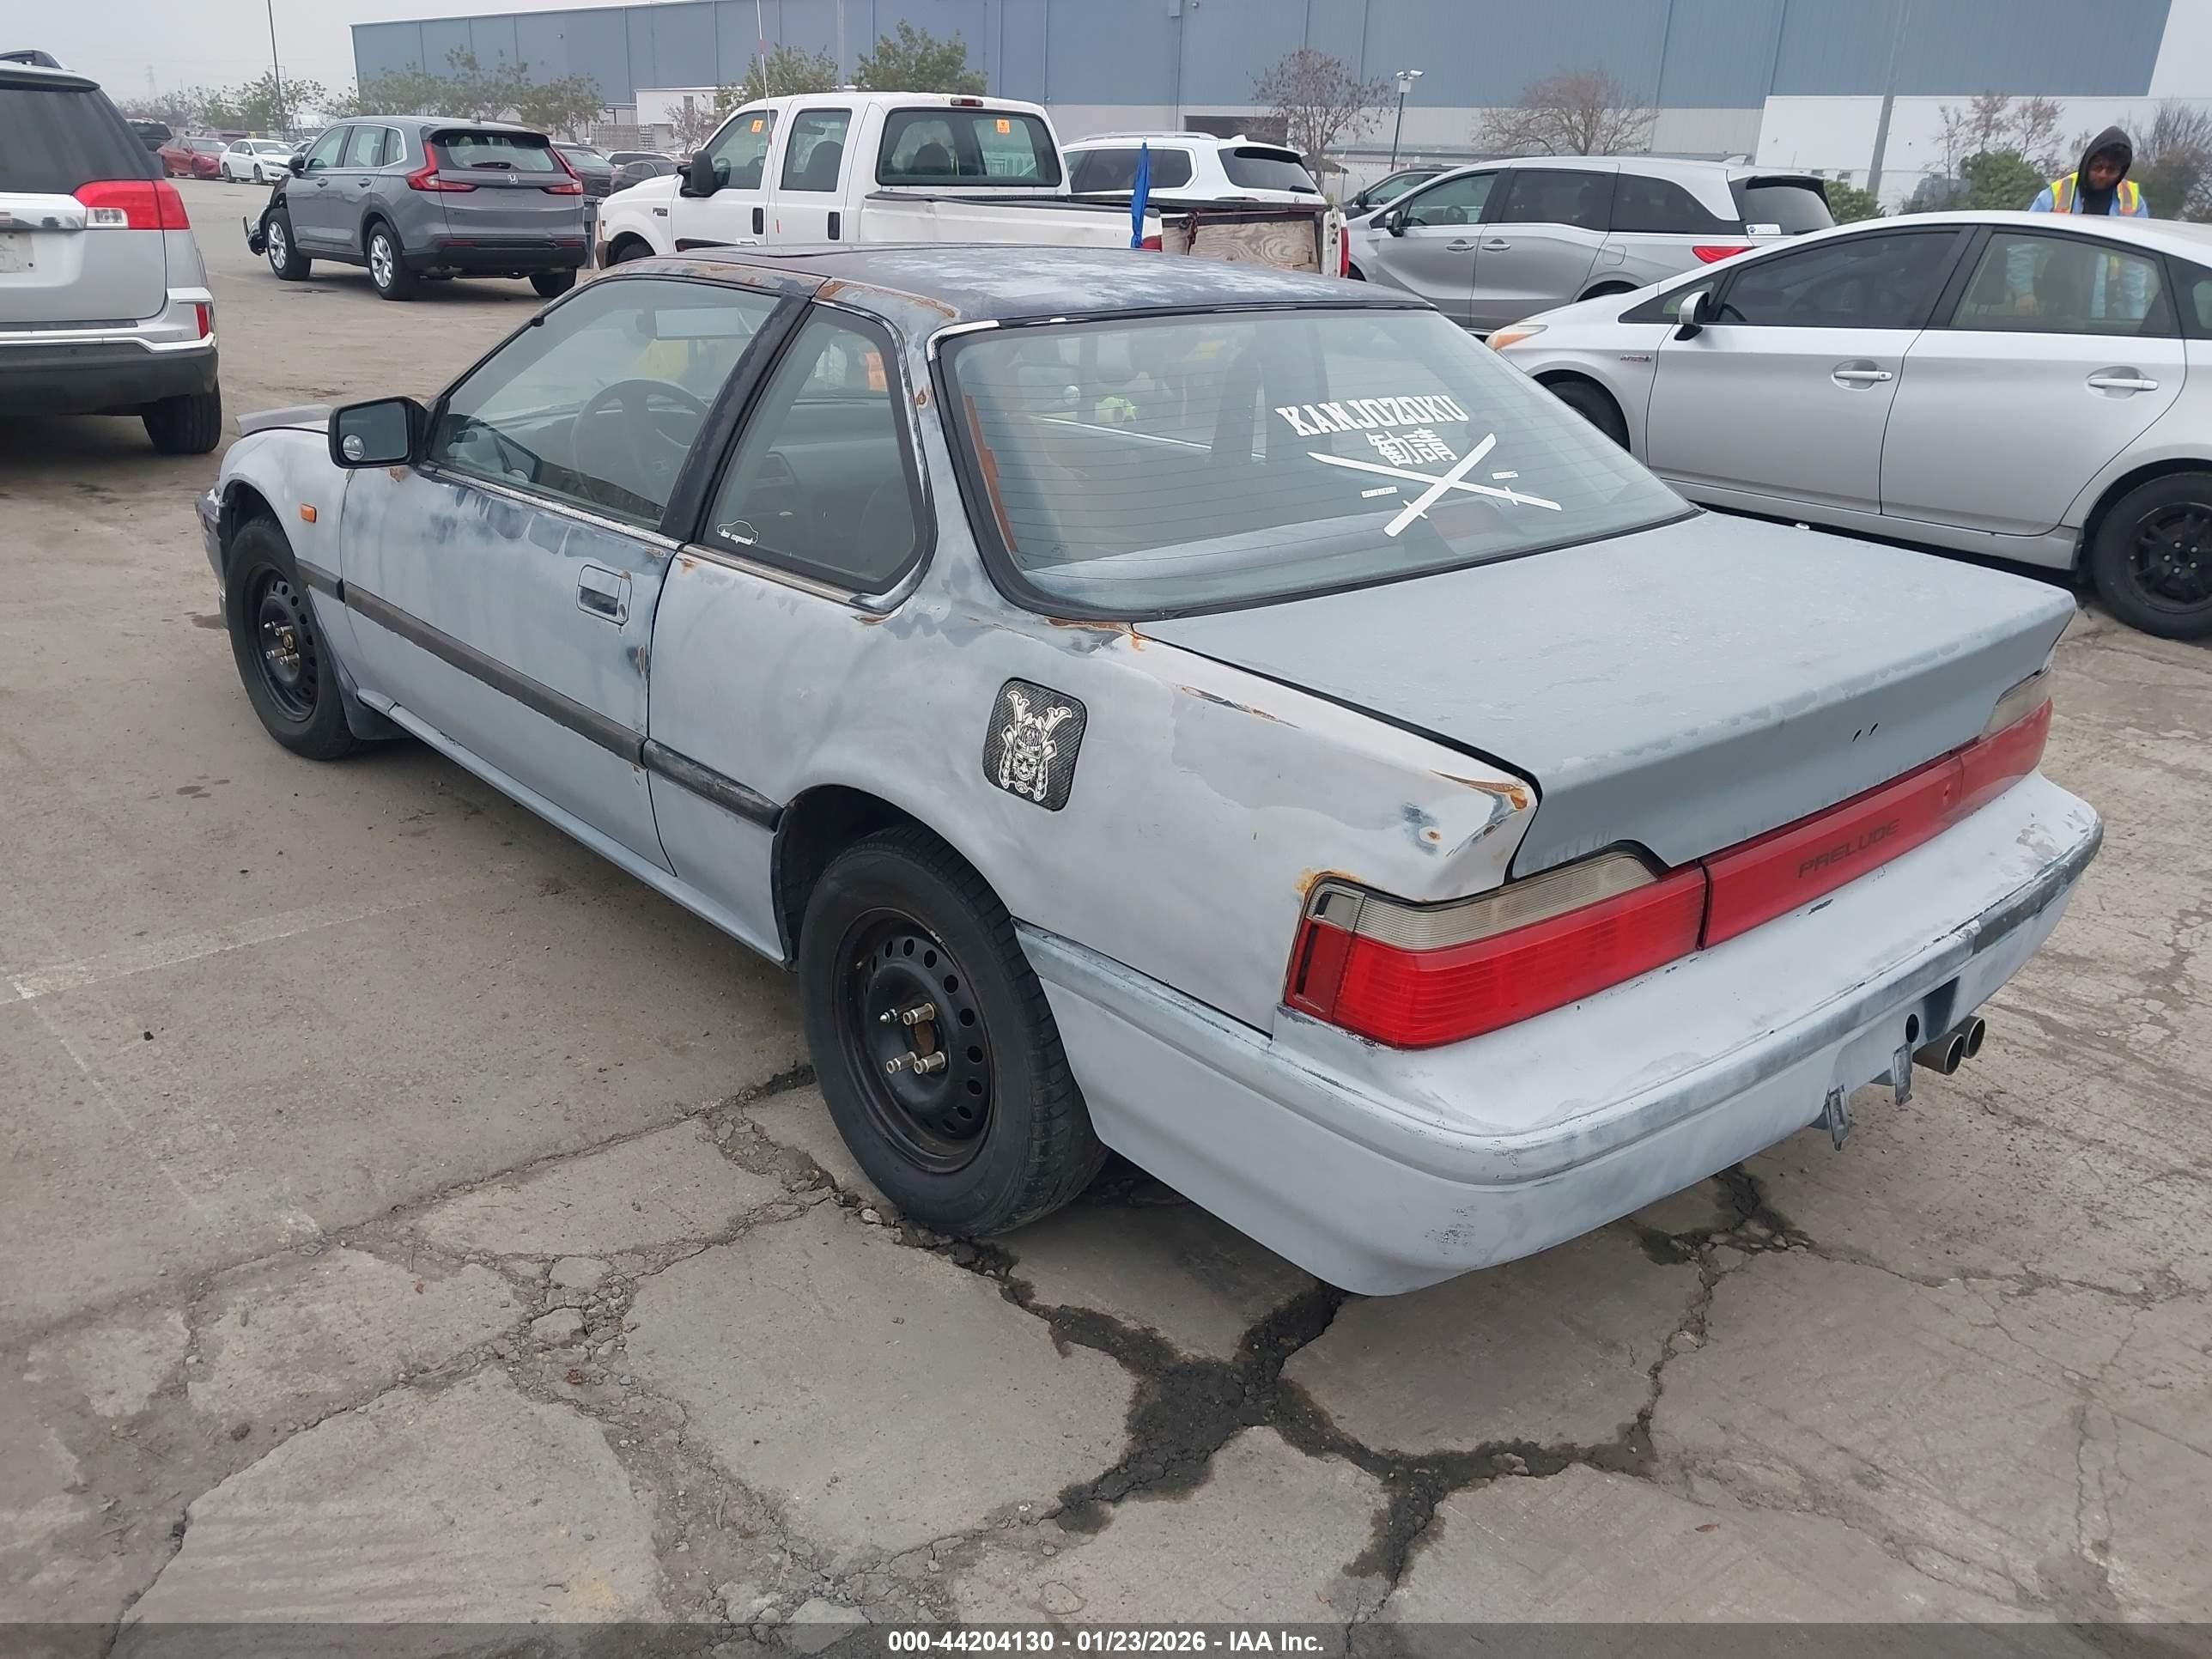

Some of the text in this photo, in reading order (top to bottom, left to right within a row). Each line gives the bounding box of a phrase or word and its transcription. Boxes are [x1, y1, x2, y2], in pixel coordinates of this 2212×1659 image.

[1274, 395, 1470, 437] KANJOZOKU
[1364, 428, 1458, 467] 勧請
[1799, 818, 1900, 879] PRELUDE
